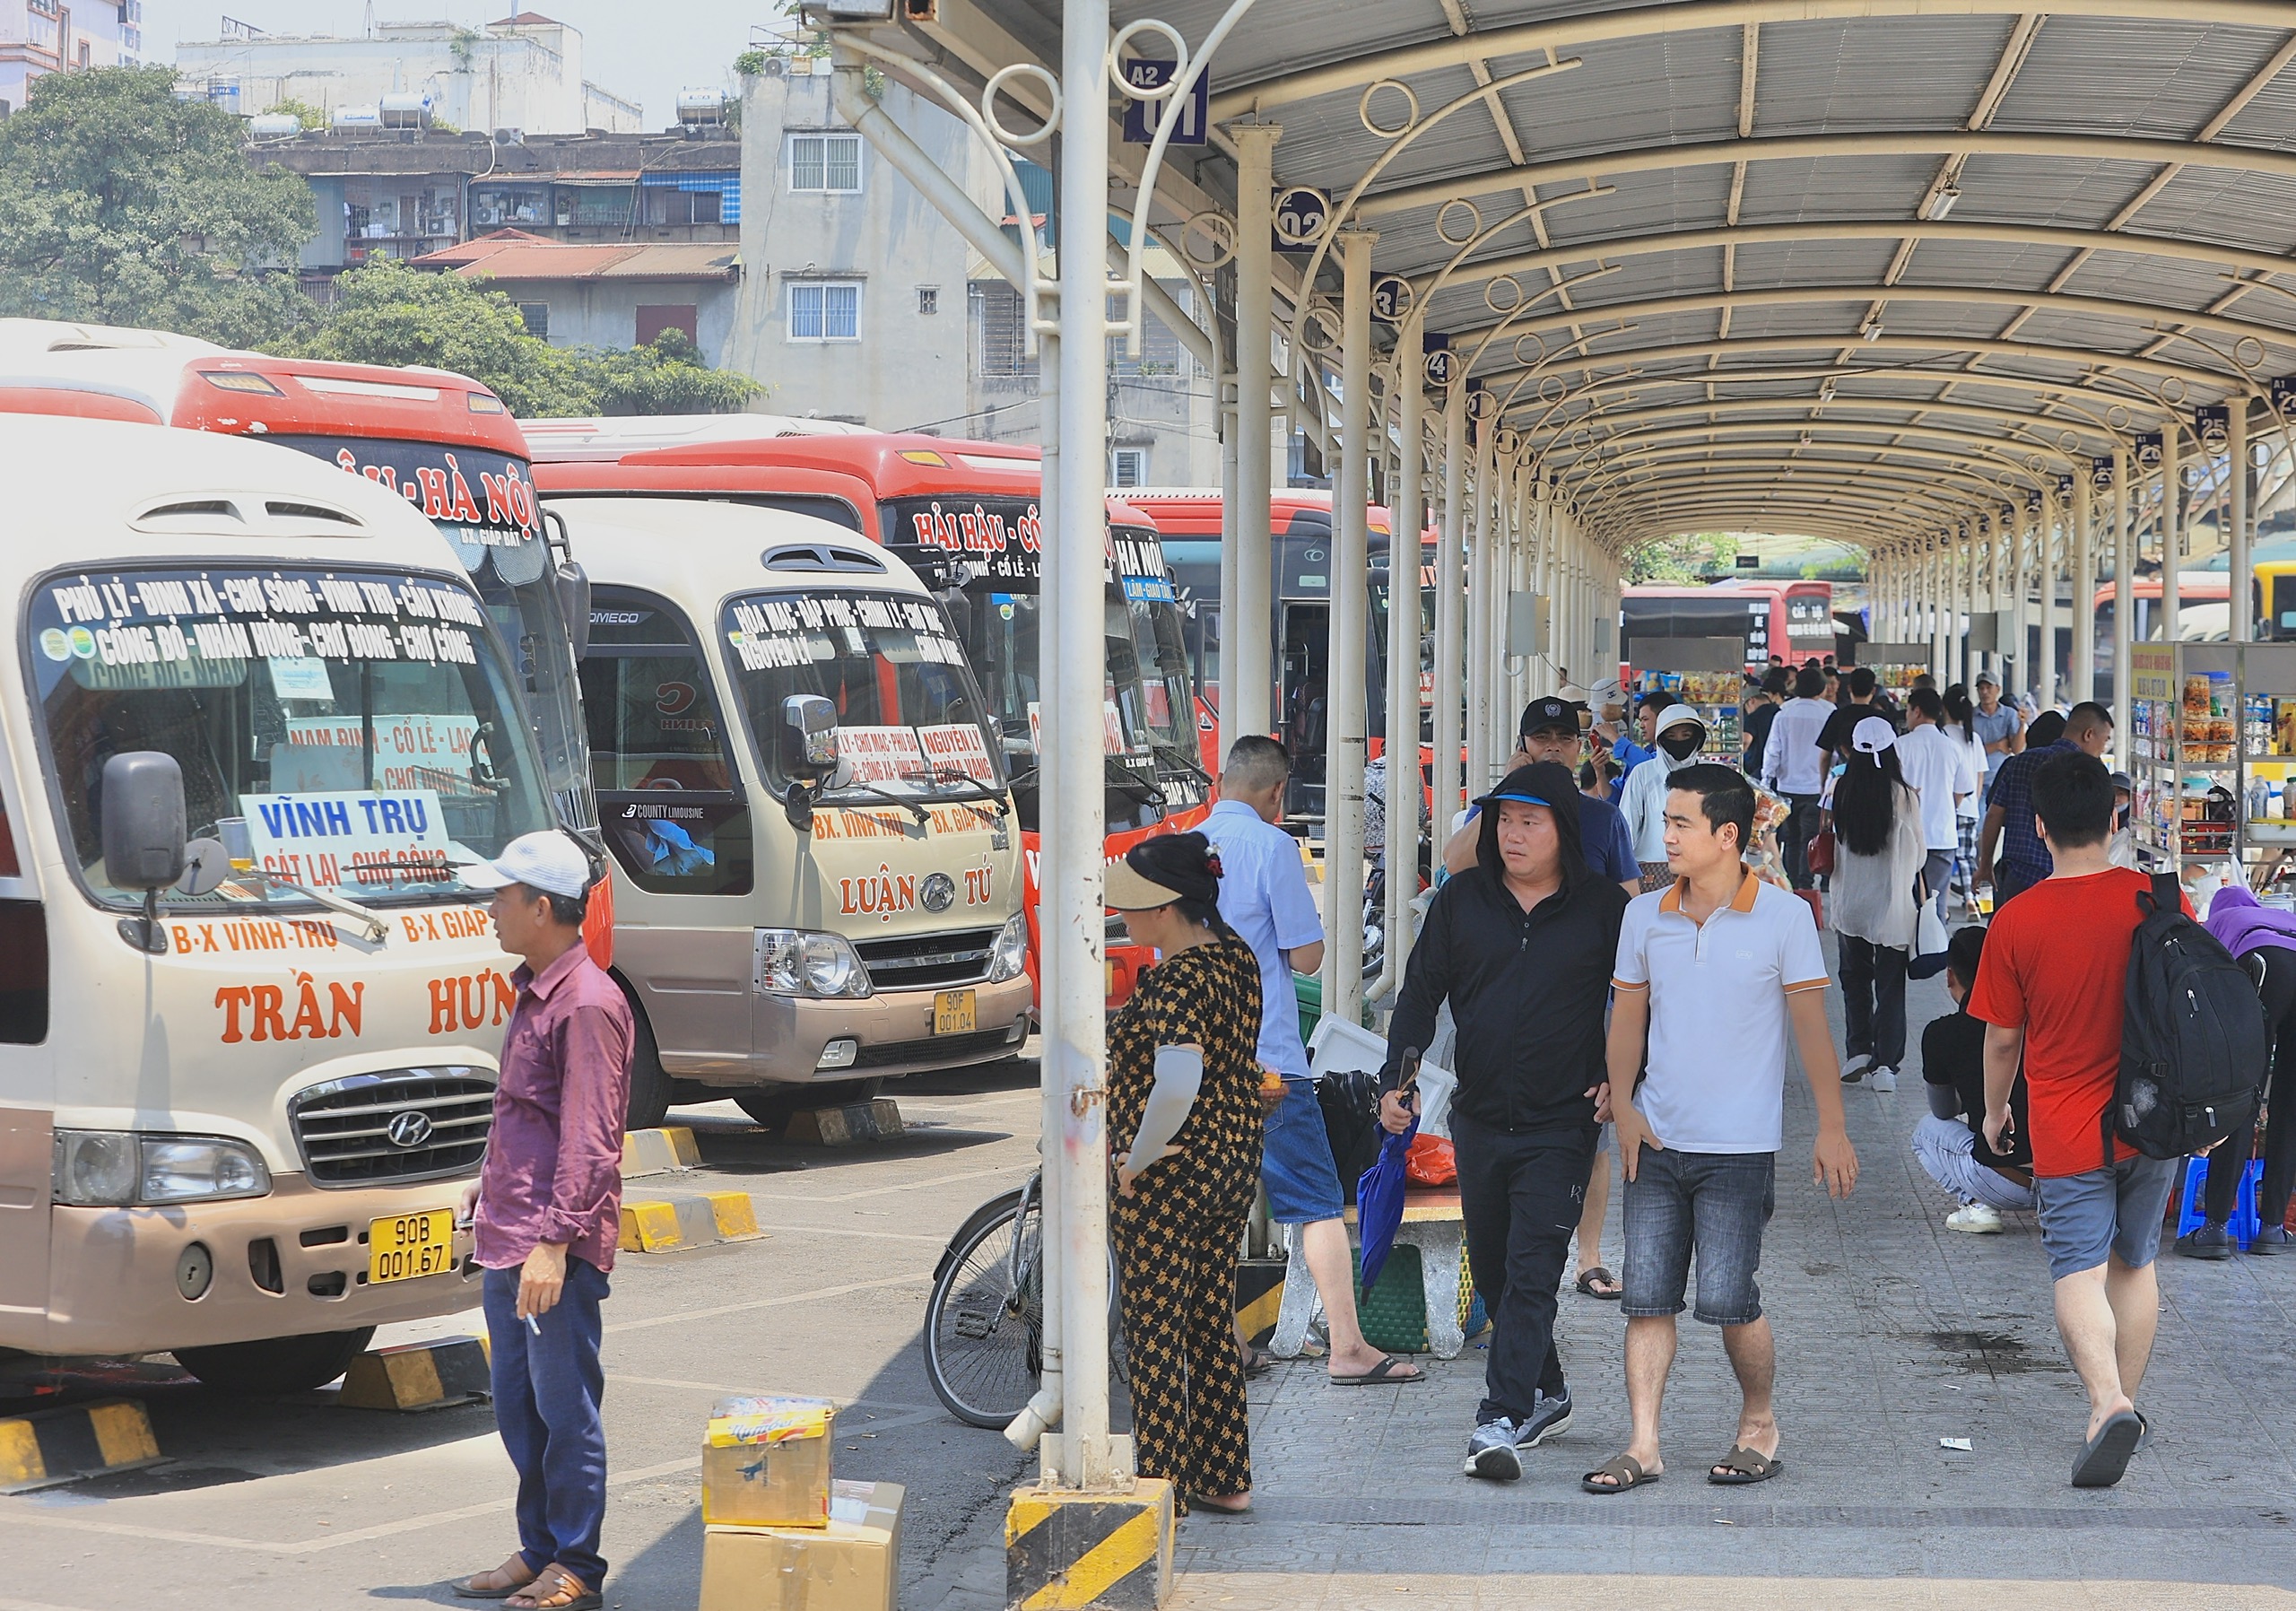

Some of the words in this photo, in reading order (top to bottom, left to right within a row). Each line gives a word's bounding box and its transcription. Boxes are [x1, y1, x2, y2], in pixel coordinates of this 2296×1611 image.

[1130, 65, 1159, 85] A2
[1279, 212, 1324, 246] 02
[2197, 409, 2208, 417] A1
[2201, 418, 2225, 437] 25
[416, 453, 482, 523] HÀ
[480, 462, 540, 541] NỘI
[479, 526, 501, 546] GIÁP
[502, 527, 521, 547] BÁT
[913, 501, 961, 553] HẢI
[960, 503, 1006, 562] HẬU
[1115, 534, 1142, 576] HÀ
[1138, 535, 1165, 583] NỘI
[52, 575, 104, 624] PHỦ
[101, 576, 132, 618] LÝ
[222, 577, 269, 619] CHỢ
[264, 572, 318, 614] SÔNG
[359, 581, 399, 622] TRỤ
[733, 600, 770, 635] HÒA
[762, 601, 798, 635] MẠC
[821, 594, 857, 627] PHÚC
[886, 597, 905, 629] LÝ
[193, 615, 253, 659] NHÂN
[309, 620, 349, 666] CHỢ
[399, 624, 437, 667] CHỢ
[793, 631, 813, 664] LÝ
[393, 717, 414, 753] CỔ
[923, 726, 971, 754] NGUYÊN
[968, 725, 982, 752] LÝ
[964, 753, 994, 780] VÀNG
[1161, 777, 1183, 806] GIÁP
[258, 796, 352, 839] VĨNH
[357, 798, 428, 841] TRỤ
[638, 805, 667, 818] COUNTY
[842, 808, 877, 839] VĨNH
[876, 811, 906, 842] TRỤ
[264, 848, 303, 889] CÁT
[306, 853, 342, 893] LẠI
[352, 848, 394, 891] CHỢ
[396, 843, 452, 884] SÔNG
[839, 862, 916, 923] LUẬN
[441, 905, 489, 939] GIÁP
[214, 967, 365, 1044] TRẦN
[427, 966, 517, 1035] HƯN
[945, 992, 964, 1011] 90F
[939, 1013, 971, 1032] 001.04
[396, 1216, 430, 1246] 90B
[379, 1244, 444, 1278] 001.67
